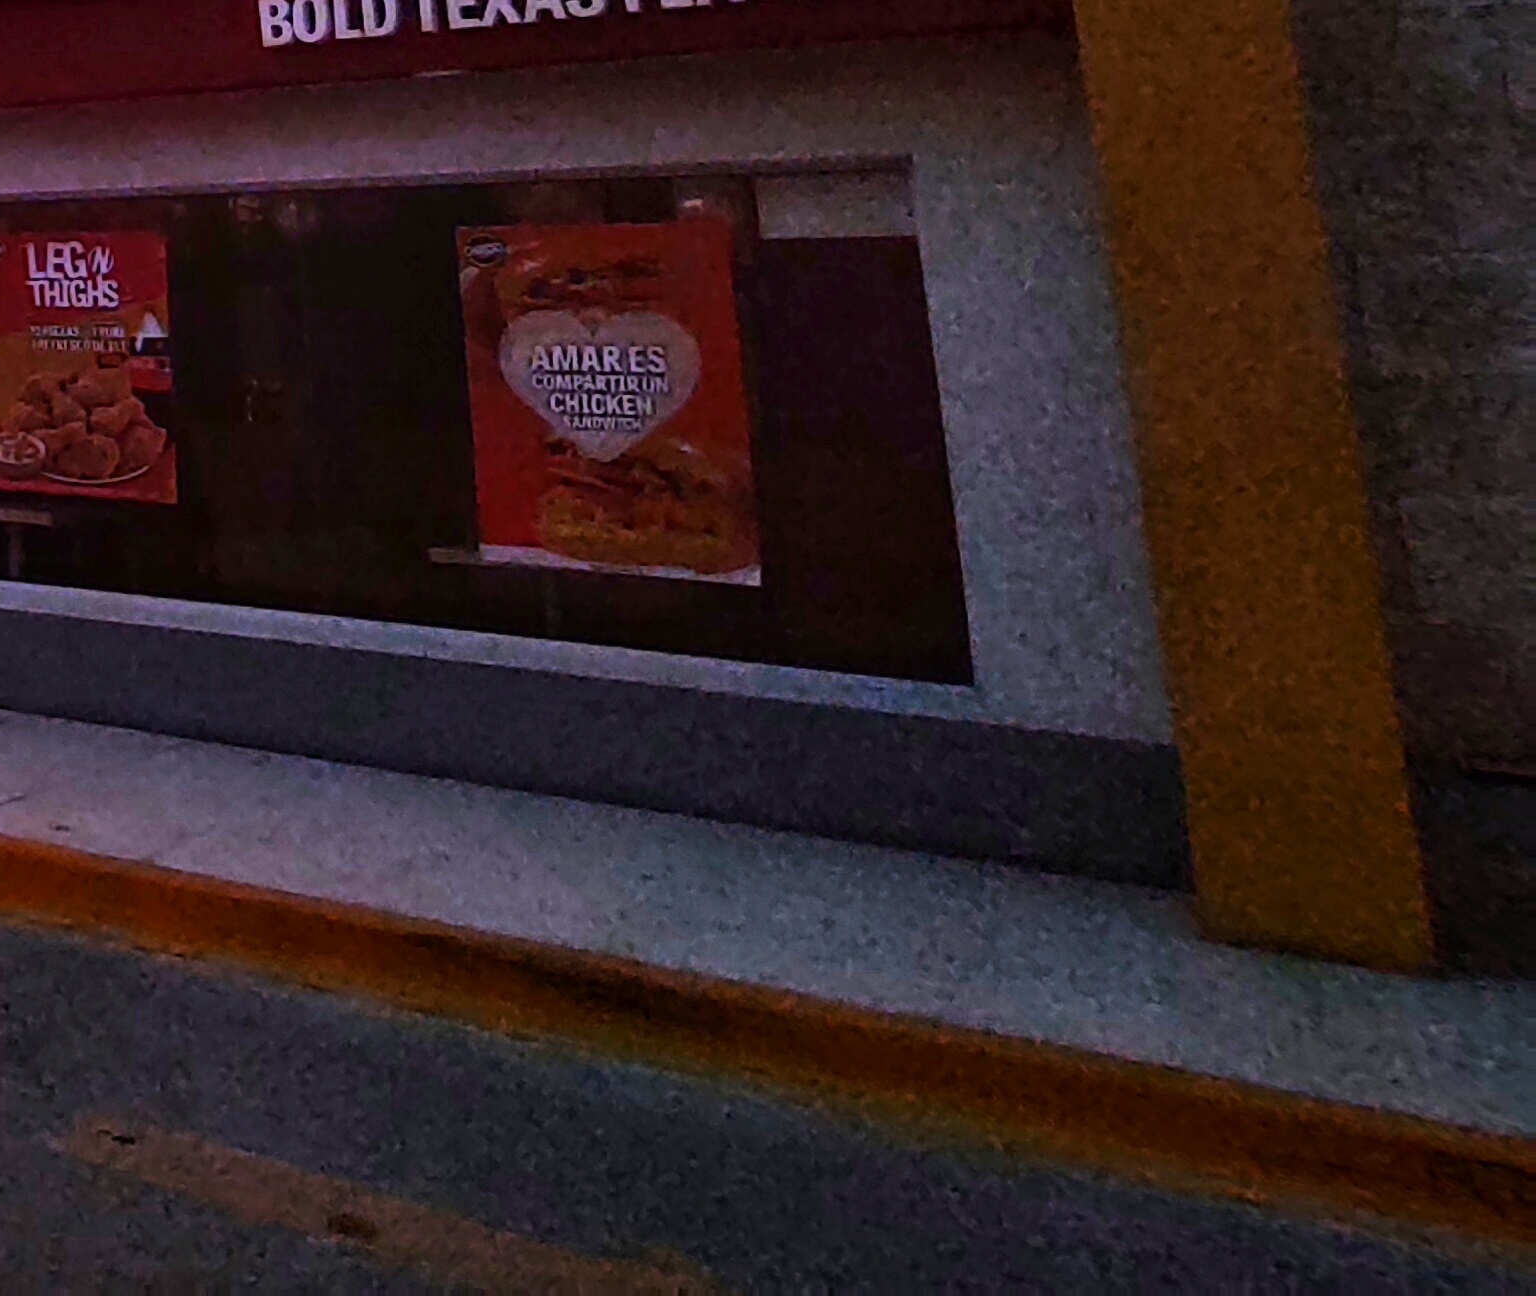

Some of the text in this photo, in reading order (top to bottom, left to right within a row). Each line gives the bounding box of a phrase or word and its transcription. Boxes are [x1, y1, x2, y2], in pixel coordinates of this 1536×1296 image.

[20, 241, 88, 279] LEG
[24, 276, 120, 309] THIGHS
[531, 343, 669, 375] AMAR ES
[531, 373, 670, 395] COMPARTIR UN
[550, 392, 656, 417] CHICKEN
